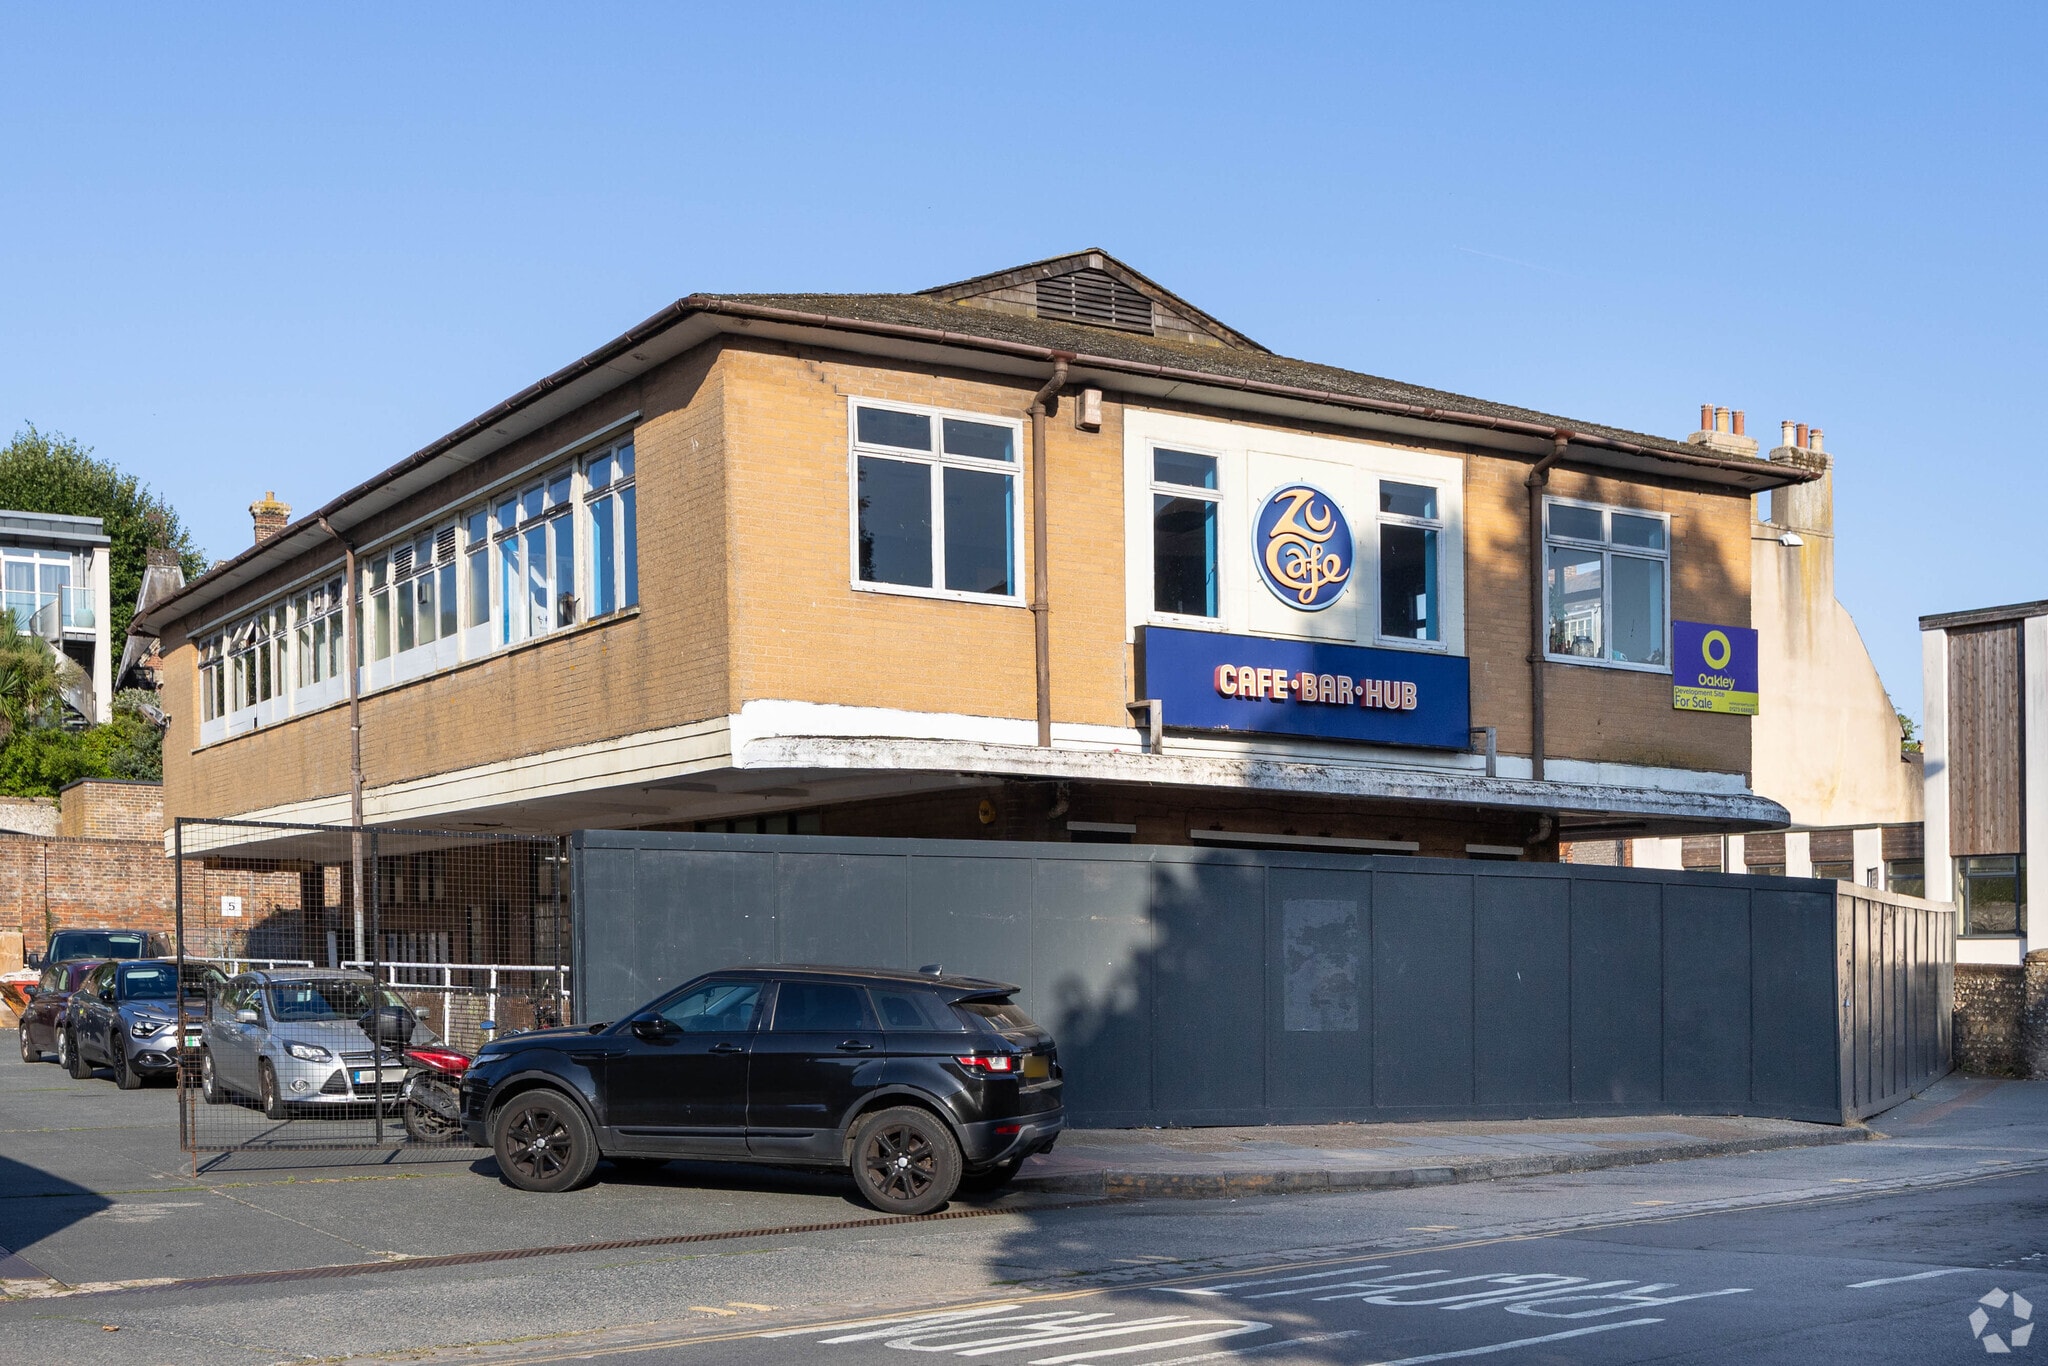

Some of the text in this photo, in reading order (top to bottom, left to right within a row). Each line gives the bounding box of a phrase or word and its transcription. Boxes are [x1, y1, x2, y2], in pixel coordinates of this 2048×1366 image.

[1269, 488, 1337, 543] Zu
[1698, 673, 1736, 691] Oakley
[1675, 687, 1713, 697] Development
[1675, 695, 1713, 709] For Sale
[228, 901, 236, 911] 5
[1148, 1264, 1753, 1319] RIGHT
